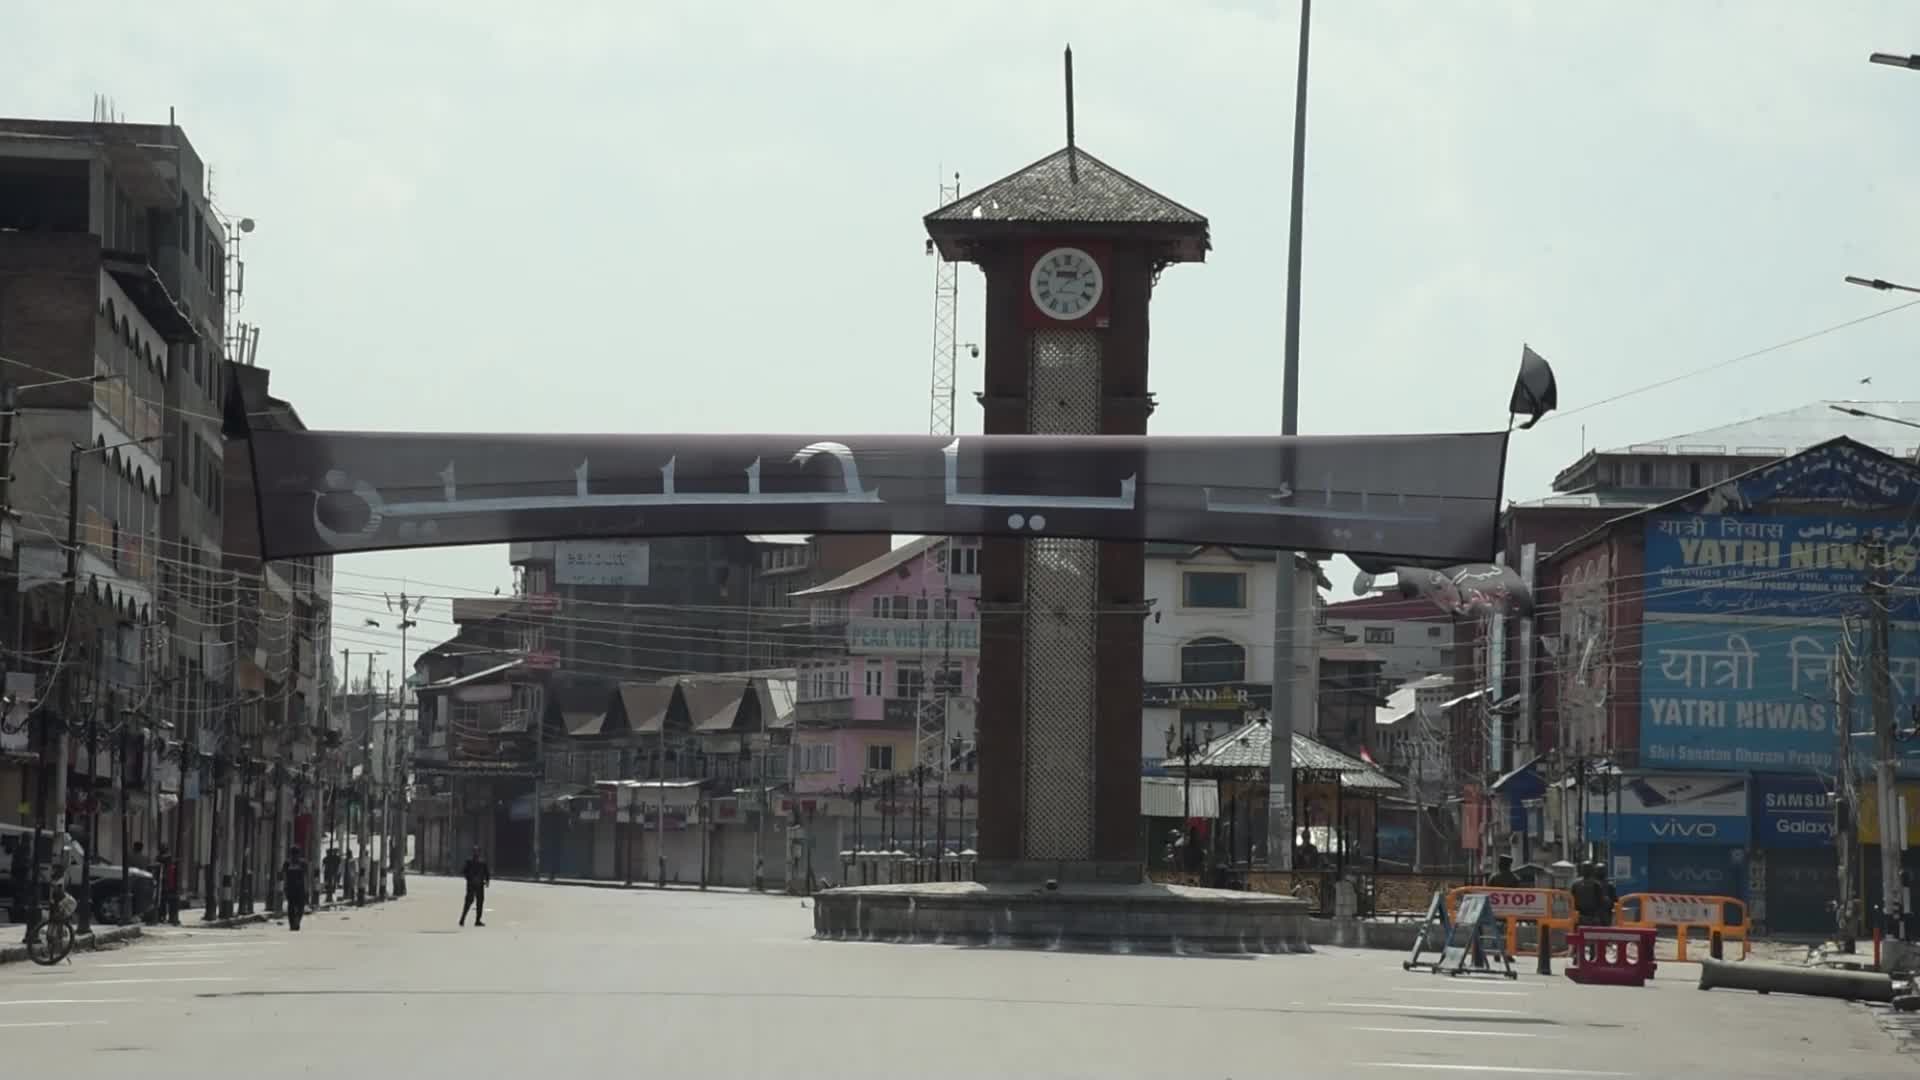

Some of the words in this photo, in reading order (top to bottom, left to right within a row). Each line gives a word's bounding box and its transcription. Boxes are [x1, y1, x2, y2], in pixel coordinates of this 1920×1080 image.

[1679, 538, 1780, 569] YATRI
[1790, 541, 1918, 573] NIWS
[1658, 634, 1760, 689] यात्री
[1649, 698, 1726, 728] YATRI
[1736, 702, 1826, 733] NIWAS
[1765, 793, 1833, 808] SAMSU
[1650, 817, 1717, 838] vivo
[1776, 818, 1834, 838] Galaxy
[1488, 892, 1536, 906] STOP
